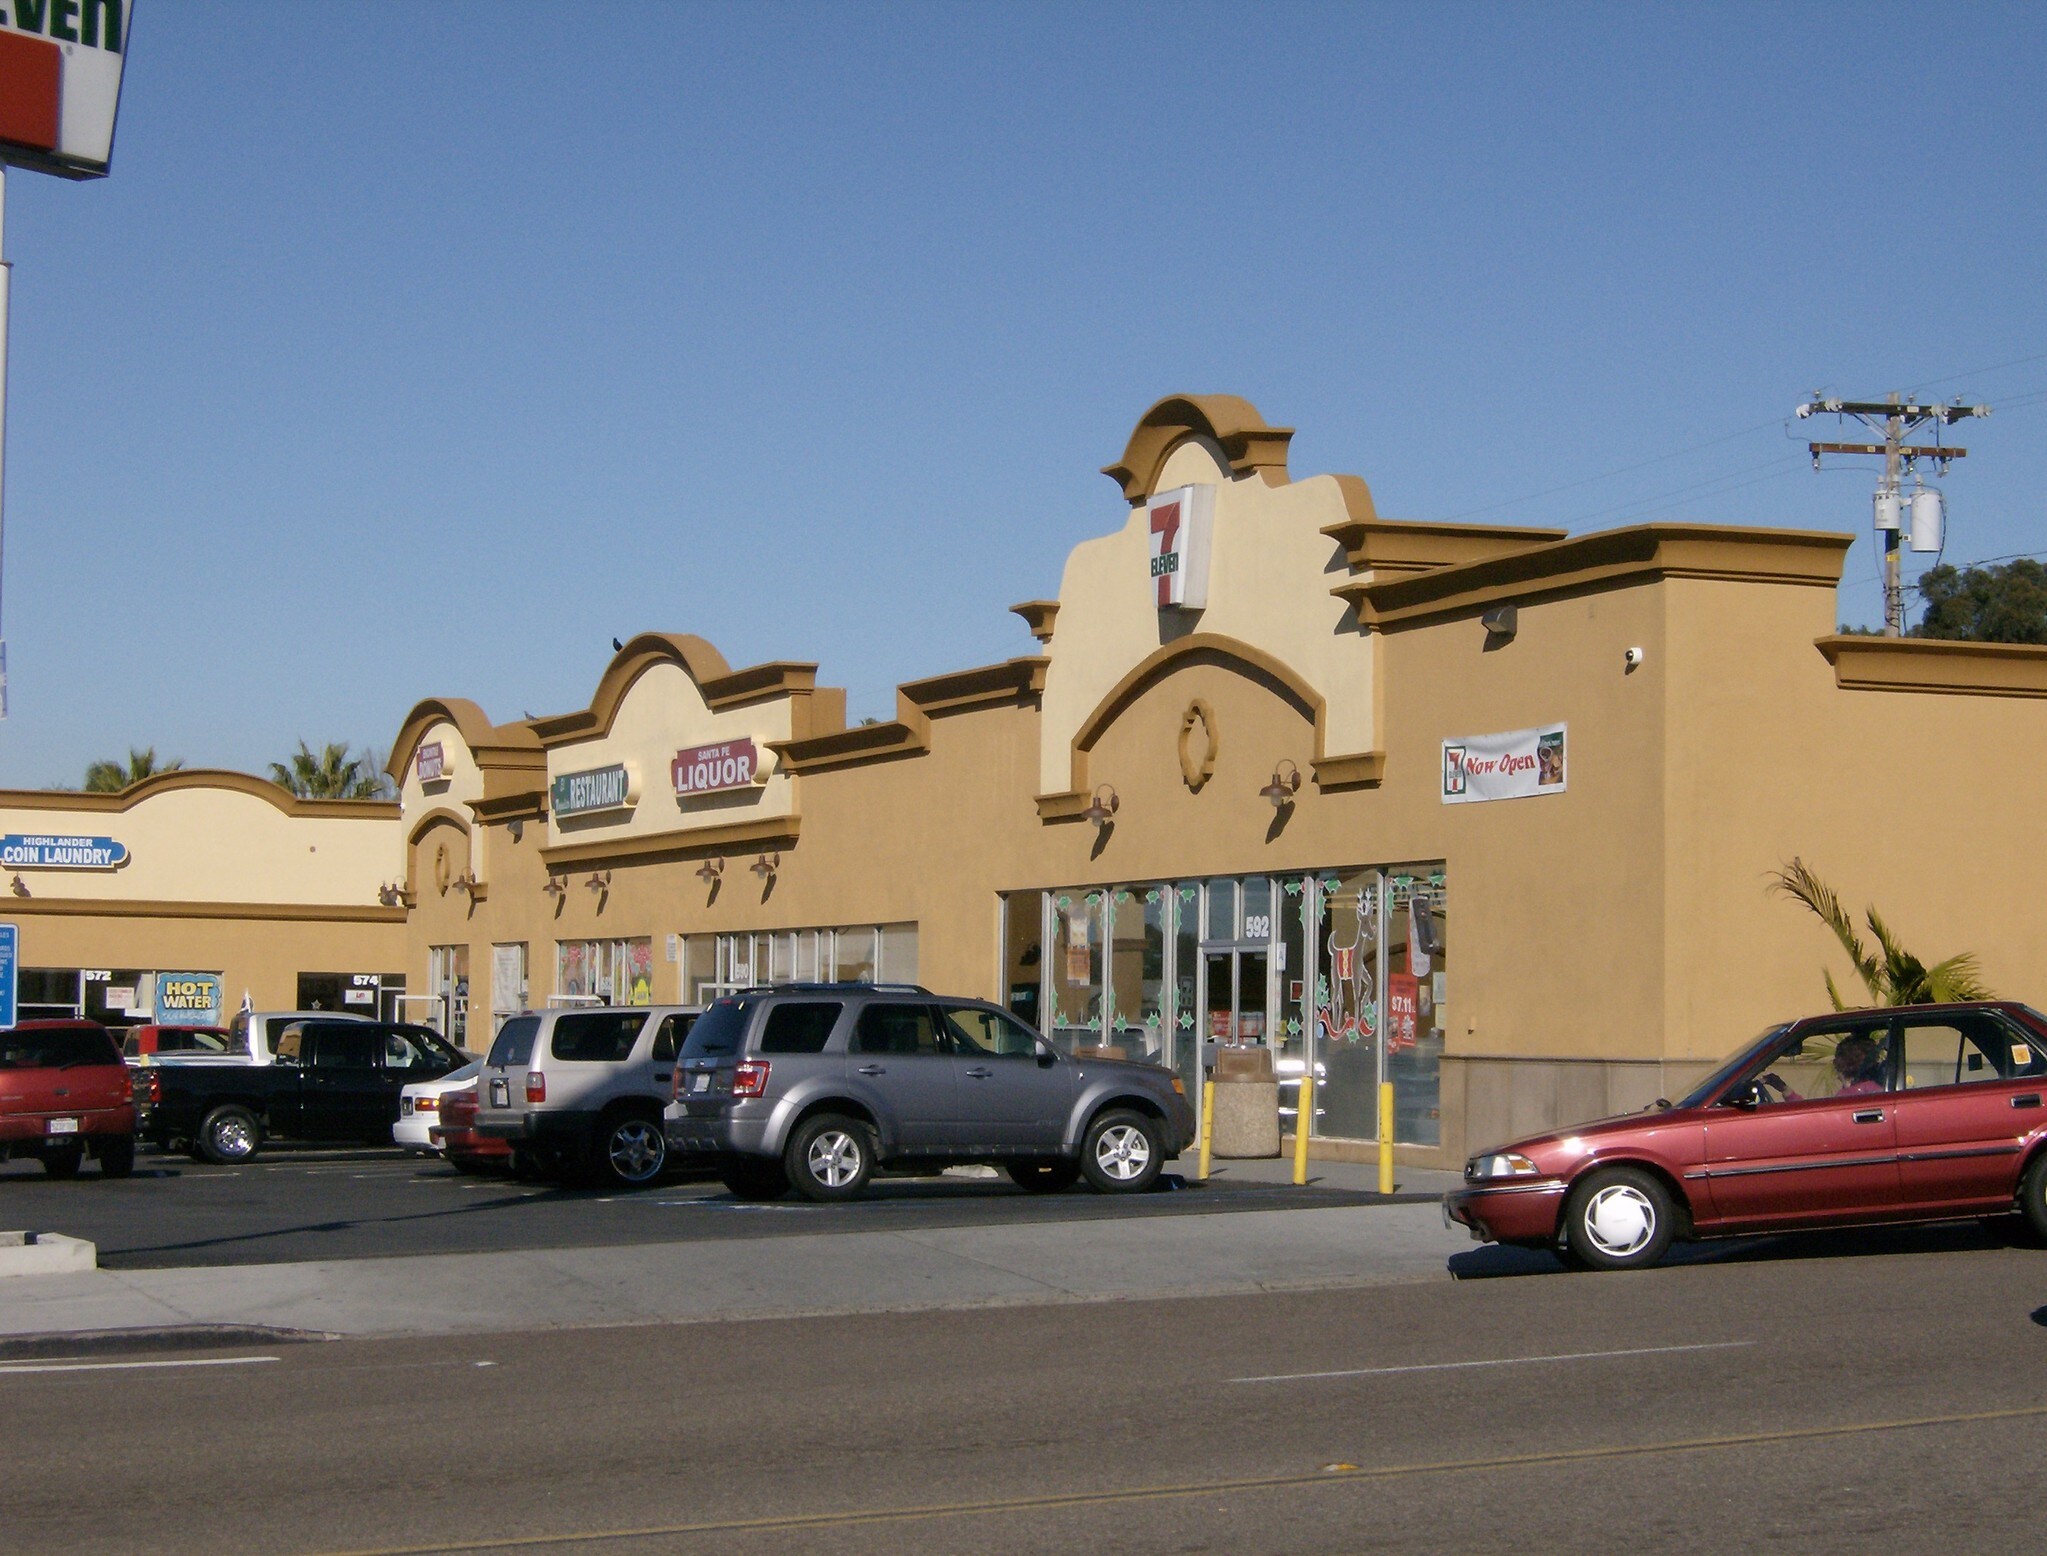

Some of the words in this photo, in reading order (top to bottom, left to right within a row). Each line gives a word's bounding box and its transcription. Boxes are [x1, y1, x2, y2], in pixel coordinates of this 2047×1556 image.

[0, 0, 122, 55] VEn
[1150, 501, 1181, 605] 7
[697, 747, 720, 762] SANTA
[721, 746, 730, 757] FE
[677, 755, 751, 792] LIQUOR
[1466, 757, 1498, 776] Now
[1499, 753, 1536, 776] Open
[570, 769, 624, 810] RESTAURANT
[23, 836, 93, 848] HIGHLANDER
[3, 846, 40, 863] COIN
[44, 847, 112, 864] LAUNDRY
[1246, 915, 1270, 938] 592
[85, 970, 111, 981] 572
[353, 975, 379, 986] 574
[166, 982, 214, 996] HOT
[162, 996, 212, 1009] WATER
